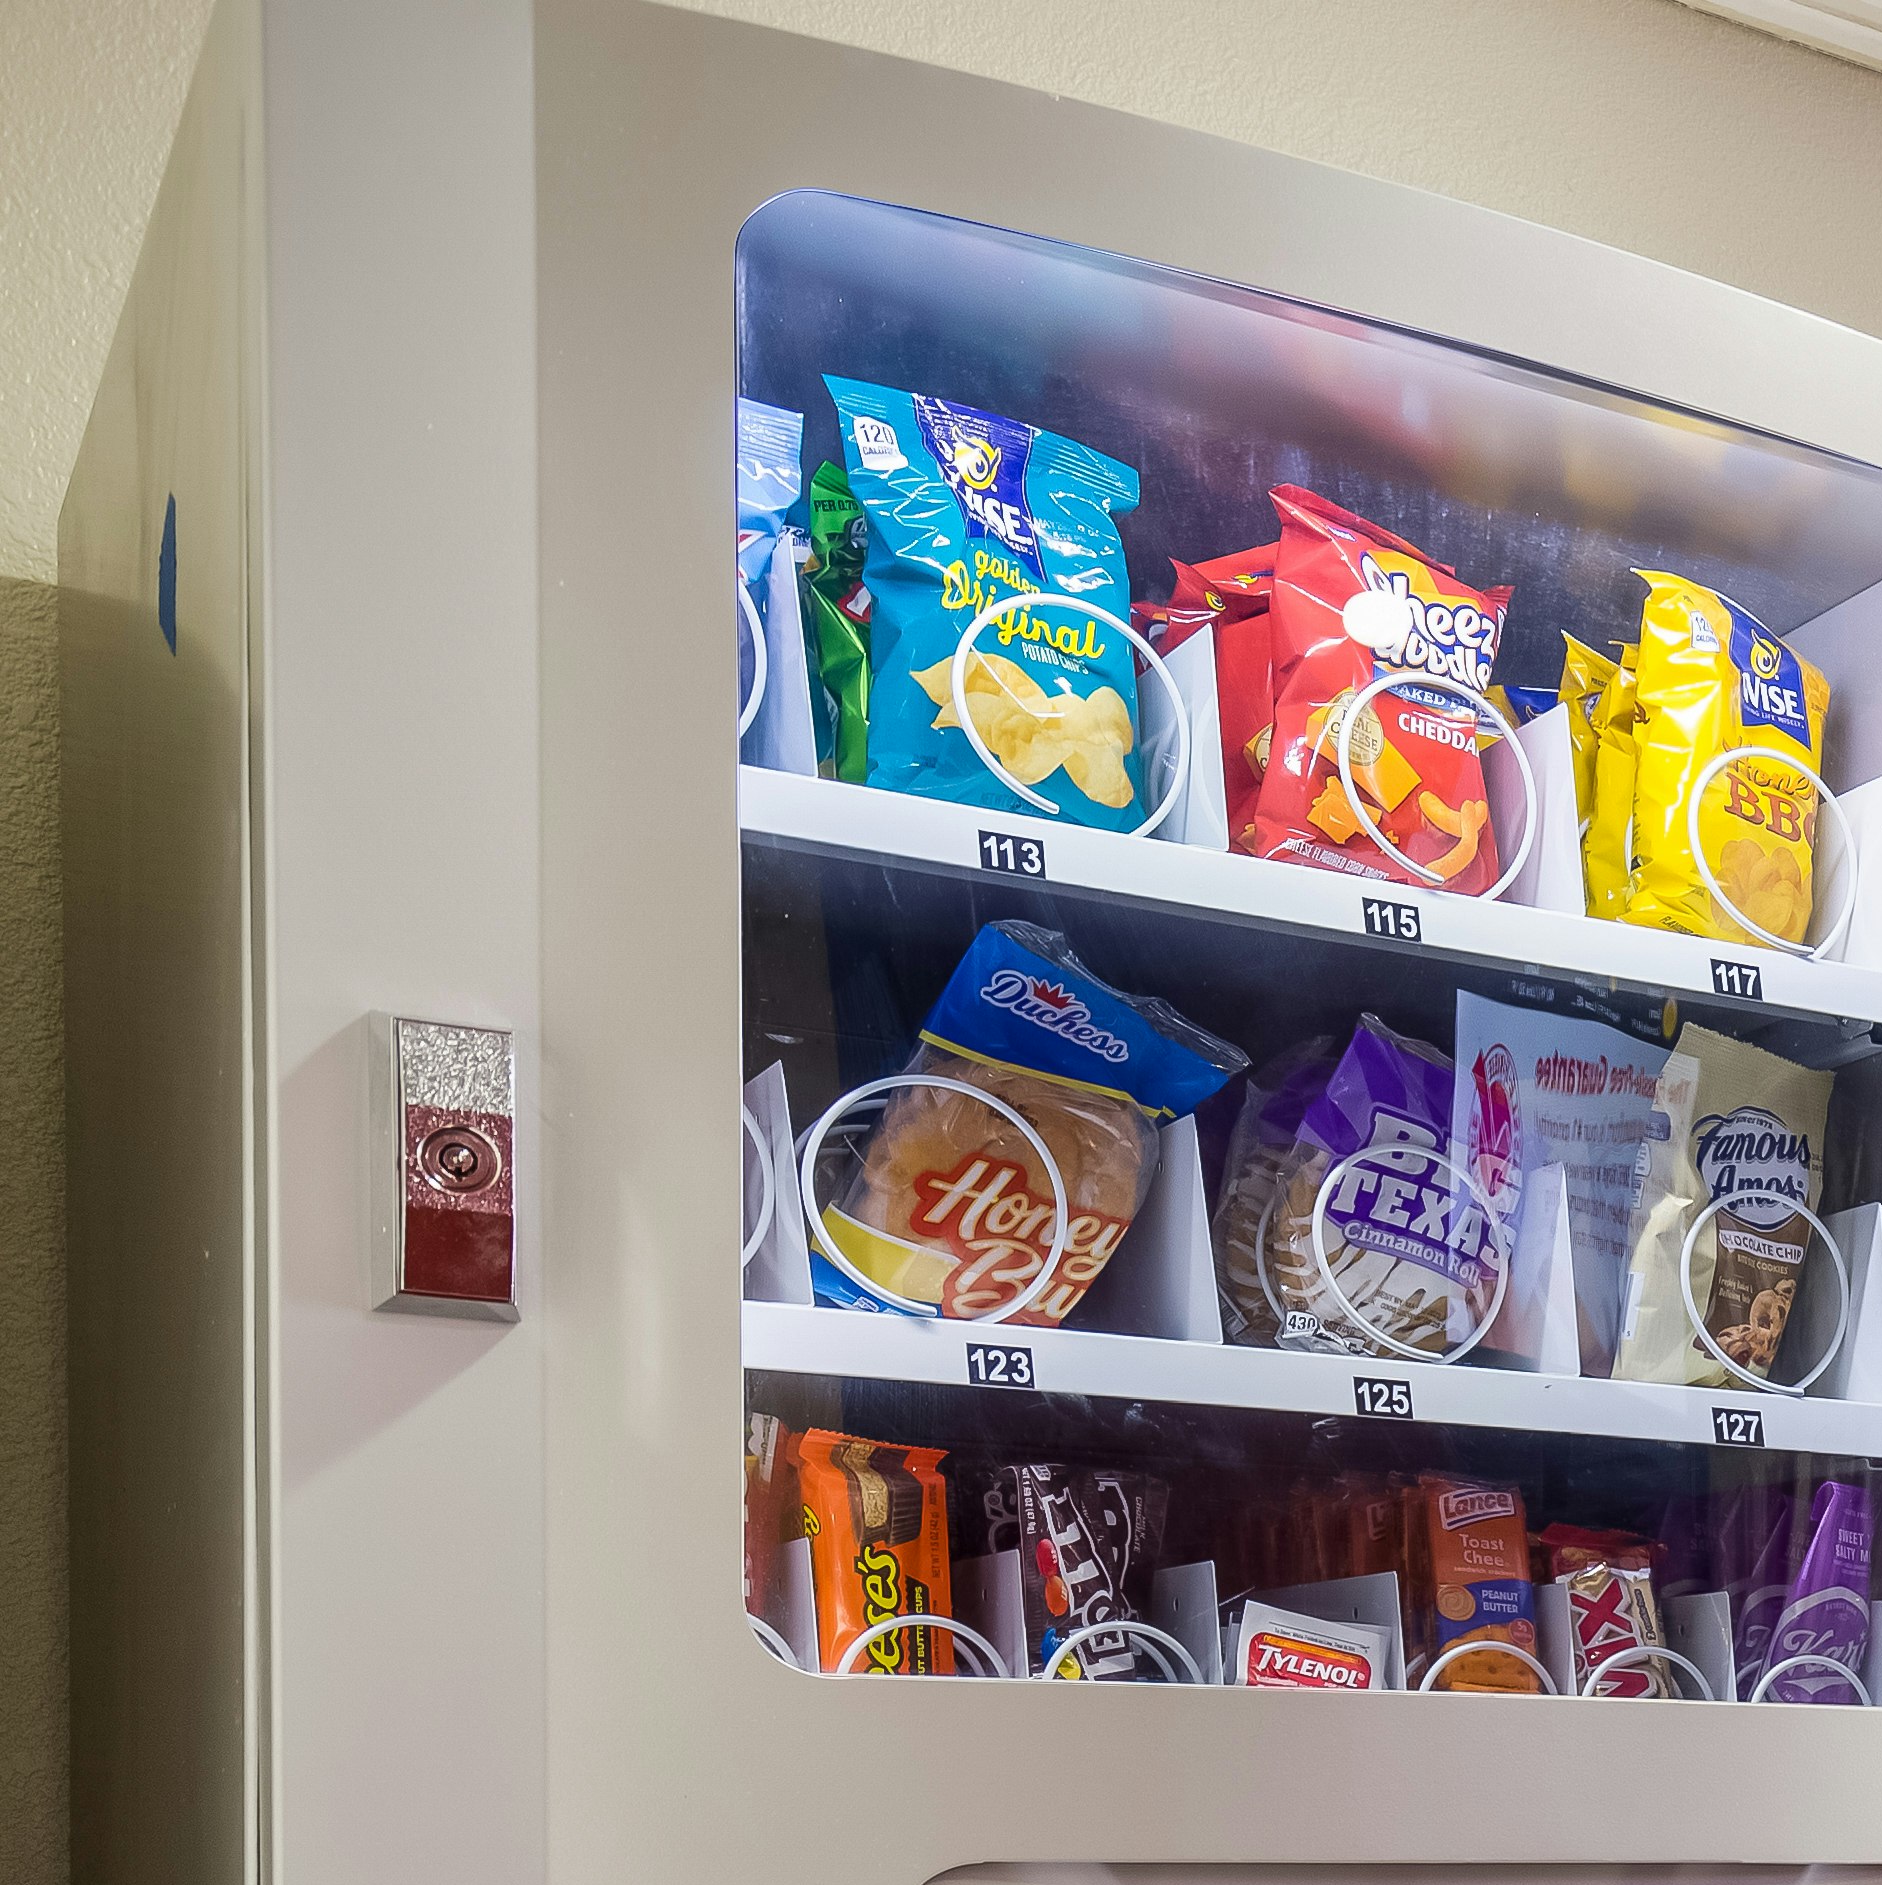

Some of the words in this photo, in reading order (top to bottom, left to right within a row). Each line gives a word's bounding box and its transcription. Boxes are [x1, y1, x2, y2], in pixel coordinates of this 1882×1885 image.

[860, 424, 894, 444] 120
[1021, 641, 1060, 666] POTATO
[1392, 684, 1447, 707] AKED
[1329, 720, 1379, 752] CEESE
[1397, 713, 1480, 757] CHEDDA
[982, 834, 1044, 875] 113
[1365, 902, 1419, 938] 115
[1714, 963, 1758, 996] 117
[980, 968, 1129, 1063] Duchess
[1691, 1113, 1812, 1173] Famous
[924, 1159, 1126, 1277] Honey
[1330, 1166, 1512, 1262] TEXAS
[1342, 1221, 1446, 1268] Cinnamon
[1447, 1252, 1481, 1287] Roll
[1775, 1246, 1803, 1264] CHIP
[969, 1348, 1032, 1385] 123
[1356, 1381, 1410, 1417] 125
[1714, 1413, 1760, 1442] 127
[1444, 1490, 1513, 1519] Lance
[1133, 1496, 1143, 1554] CHOCOLATE
[1838, 1528, 1863, 1546] SWEET
[1458, 1533, 1505, 1551] Toast
[1835, 1544, 1856, 1562] SALTY
[914, 1586, 924, 1614] CUPS
[1481, 1589, 1519, 1602] PEANUT
[1482, 1602, 1519, 1614] BUTTER
[1258, 1644, 1359, 1688] TYLENOL
